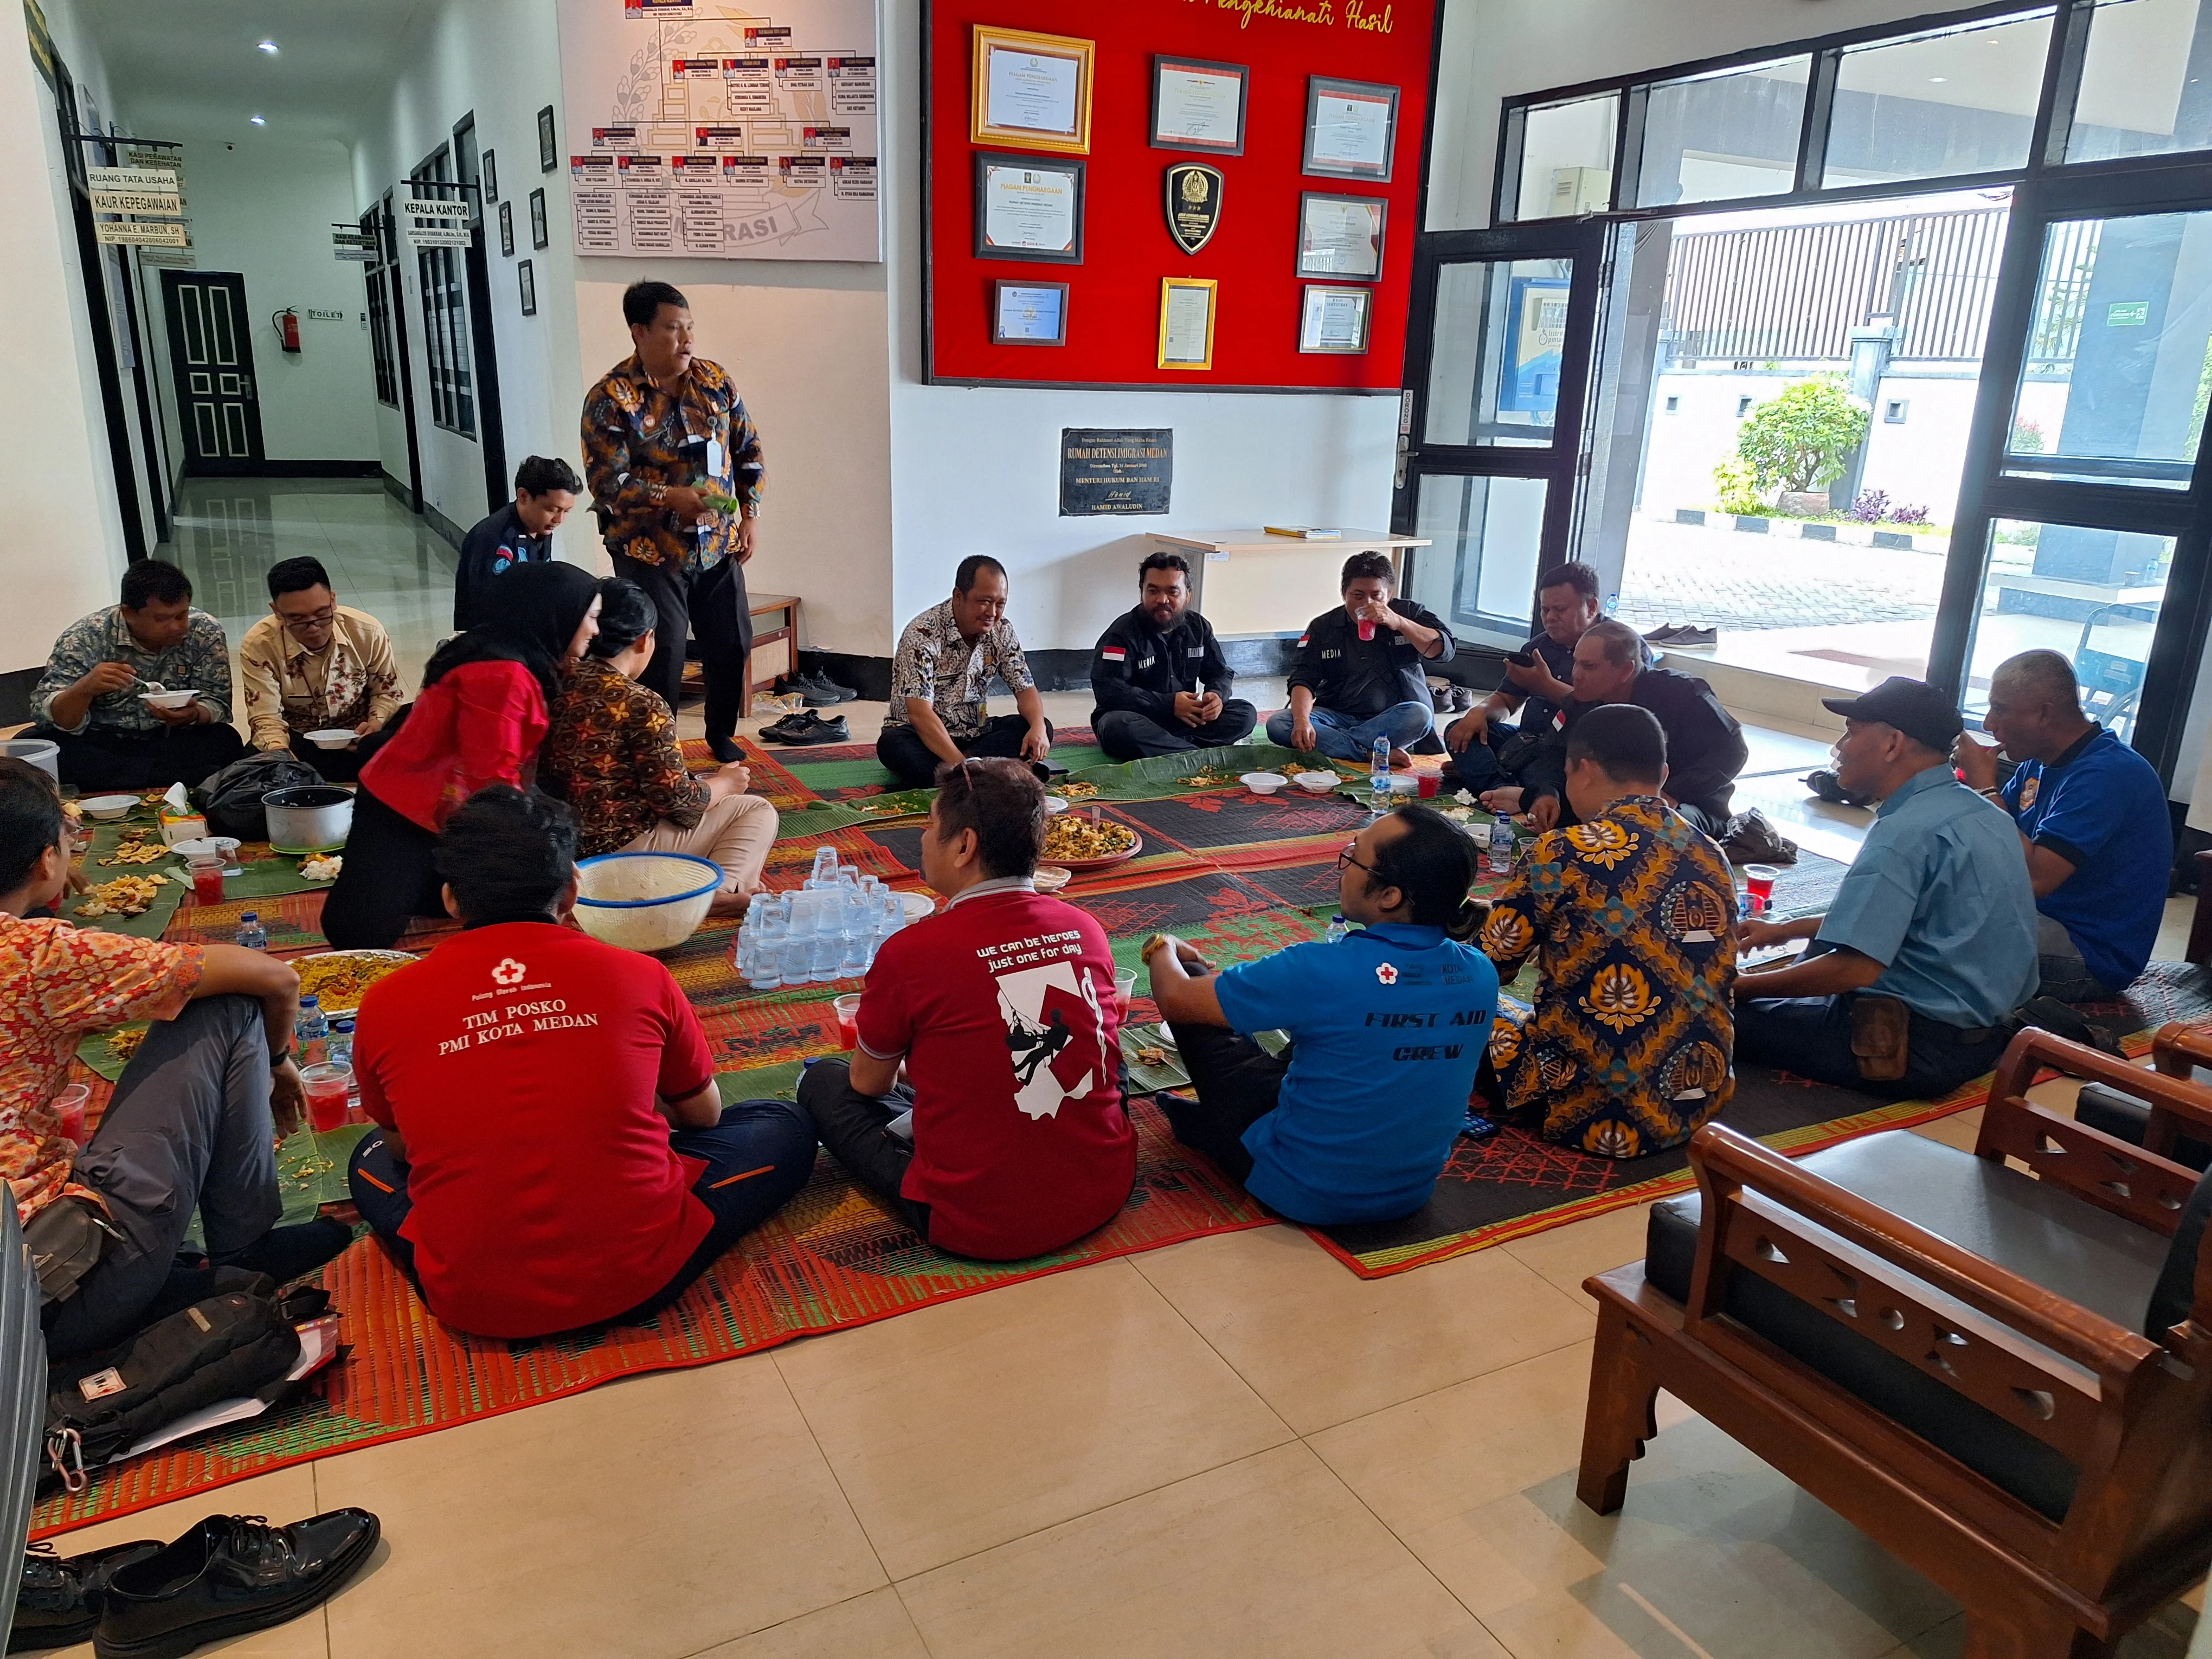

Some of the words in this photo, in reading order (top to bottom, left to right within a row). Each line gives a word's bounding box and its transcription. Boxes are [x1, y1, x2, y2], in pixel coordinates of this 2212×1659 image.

[1205, 0, 1334, 29] engkhianati
[1346, 0, 1393, 33] Hasil
[89, 173, 121, 182] RUANG
[123, 175, 143, 183] TATA
[145, 176, 175, 184] USAHA
[1023, 185, 1063, 194] PENGHARGAAN
[94, 195, 118, 209] KAUR
[120, 196, 178, 211] KEPEGAWAIAN
[404, 202, 434, 215] KEPALA
[436, 204, 468, 216] KANTOR
[100, 224, 132, 233] YOHANNA
[1068, 448, 1090, 459] RUMAH
[1091, 448, 1117, 459] DETENSI
[1117, 447, 1146, 459] IMIGRASI
[1147, 447, 1168, 459] MEDAN
[1322, 648, 1341, 659] MEDIA
[1139, 655, 1155, 670] MEDIA
[462, 1010, 499, 1030] TIM
[505, 998, 567, 1020] POSKO
[1364, 1012, 1441, 1028] FIRST
[1449, 1009, 1487, 1026] AID
[438, 1034, 471, 1056] PMI
[477, 1023, 525, 1045] KOTA
[533, 1013, 599, 1032] MEDAN
[1392, 1043, 1464, 1062] CREW
